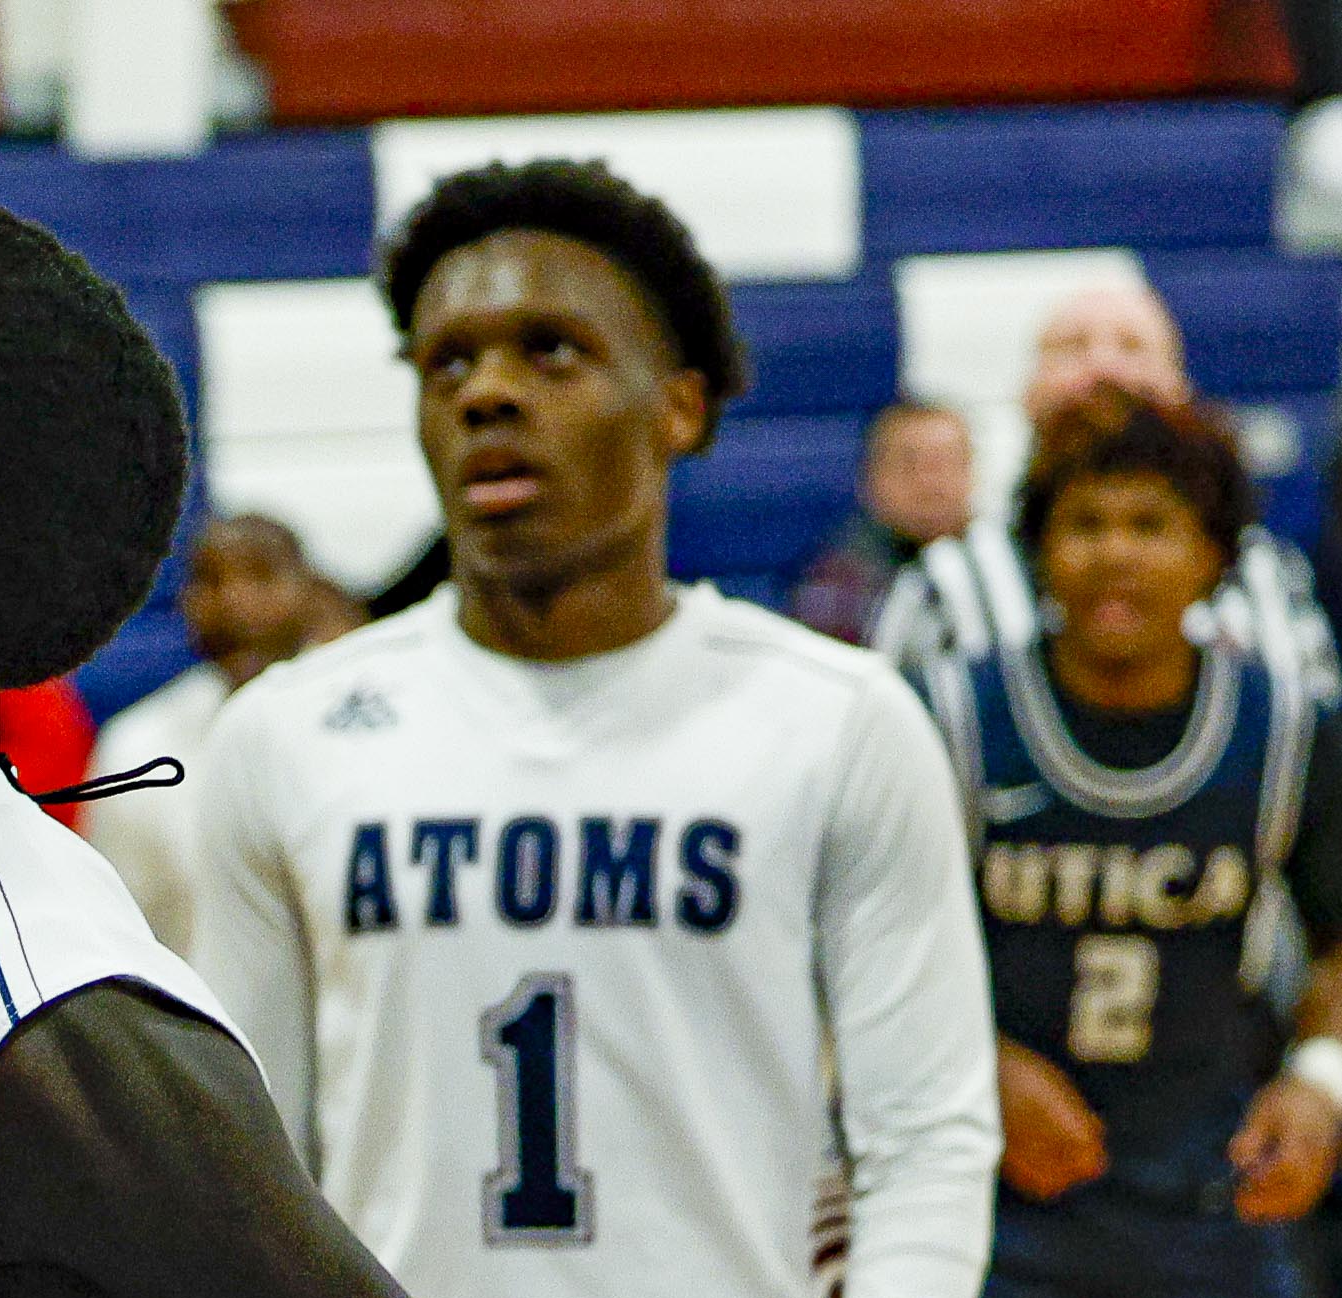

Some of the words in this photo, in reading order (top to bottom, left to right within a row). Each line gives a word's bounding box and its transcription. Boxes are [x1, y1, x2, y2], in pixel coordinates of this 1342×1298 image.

[347, 817, 742, 936] ATOMS
[982, 843, 1250, 928] UTICA
[1068, 934, 1160, 1062] 2
[480, 972, 595, 1248] 1
